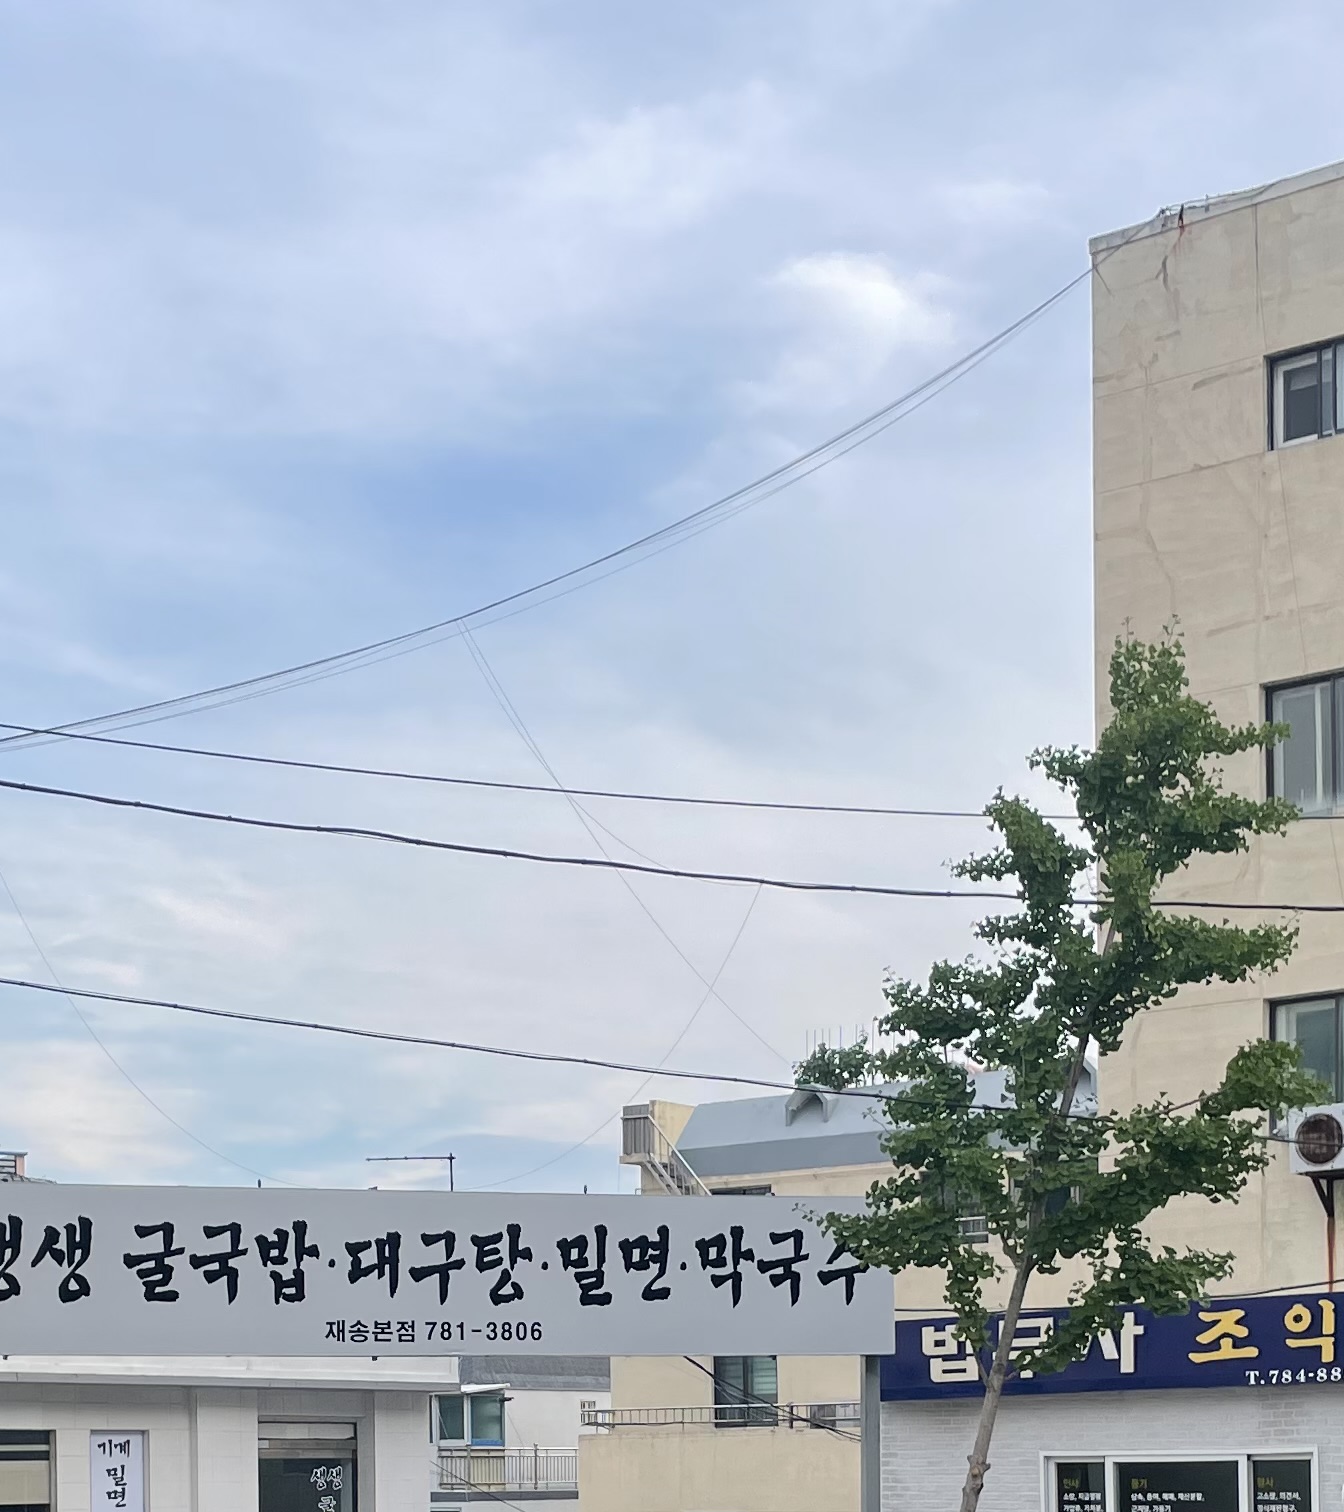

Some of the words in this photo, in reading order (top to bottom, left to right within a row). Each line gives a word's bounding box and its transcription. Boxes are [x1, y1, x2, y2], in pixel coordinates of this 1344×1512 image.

[325, 1320, 417, 1343] 재송본점
[425, 1321, 543, 1343] 781-3806
[97, 1439, 130, 1458] 기계
[105, 1464, 127, 1507] 밀면
[310, 1466, 343, 1490] 생생
